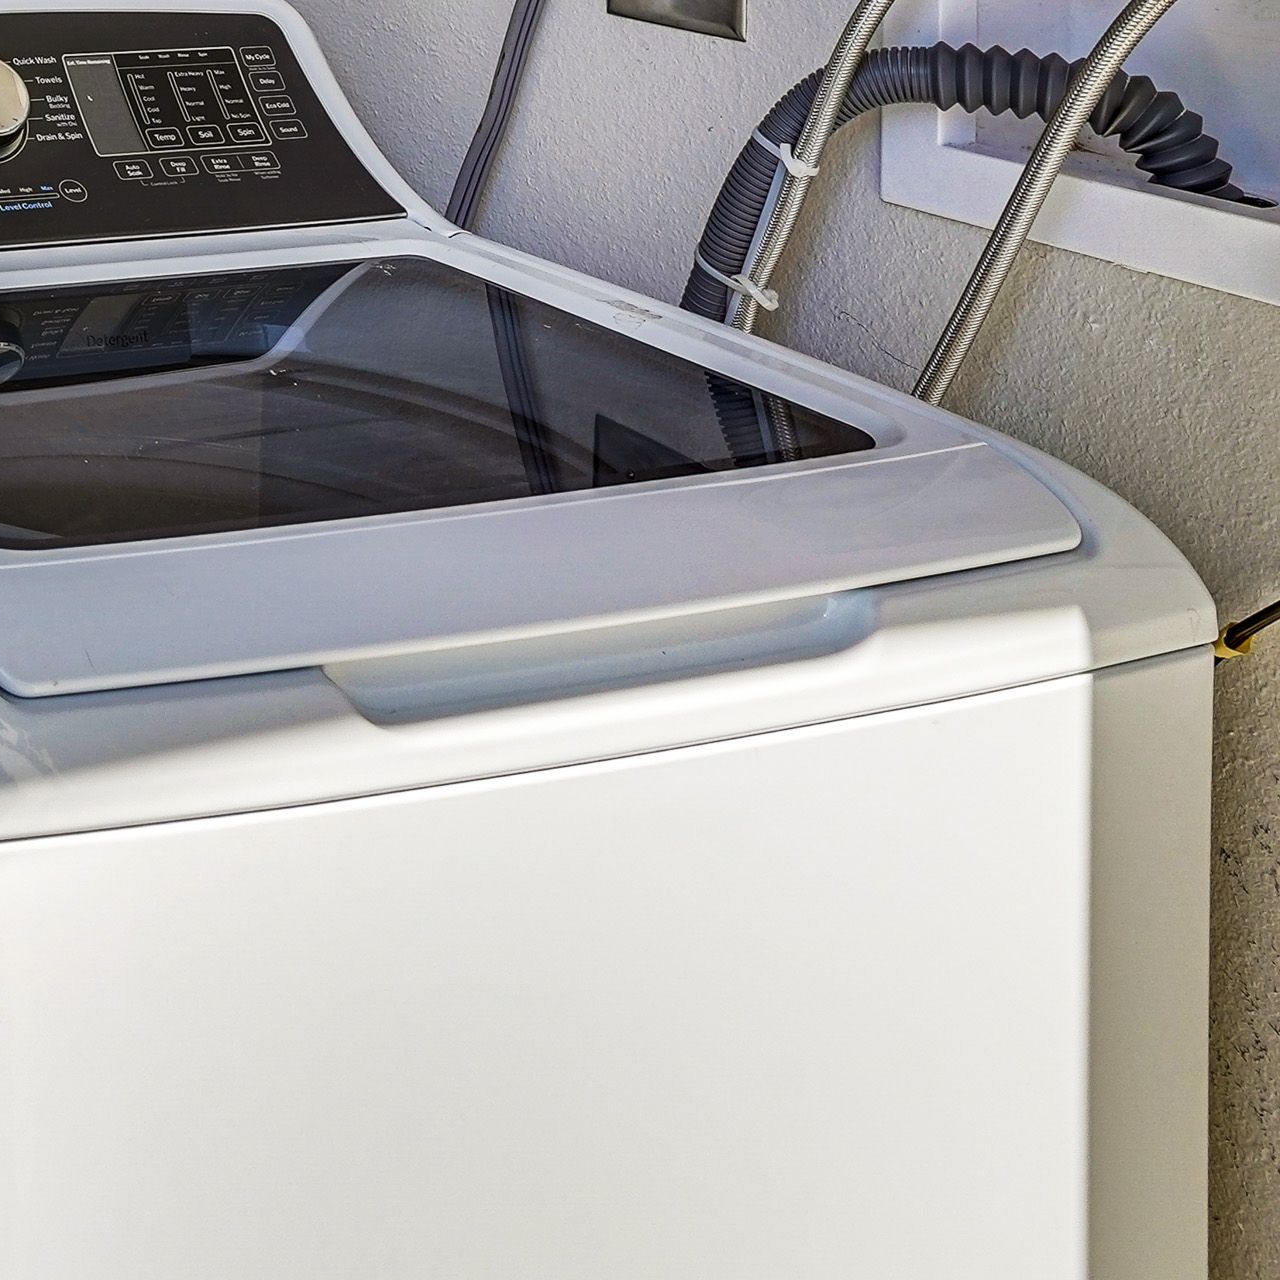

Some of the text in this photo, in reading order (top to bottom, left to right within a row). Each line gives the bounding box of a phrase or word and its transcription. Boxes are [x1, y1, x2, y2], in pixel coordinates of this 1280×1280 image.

[12, 56, 57, 66] Quick Wash
[35, 76, 63, 84] Towels
[45, 95, 68, 103] Bulky
[44, 114, 76, 122] Sanitize
[65, 132, 83, 140] Spin
[198, 131, 214, 139] Soil
[237, 128, 255, 137] Spin
[0, 203, 22, 212] Level
[23, 201, 53, 210] Control
[86, 330, 149, 348] Detergent
